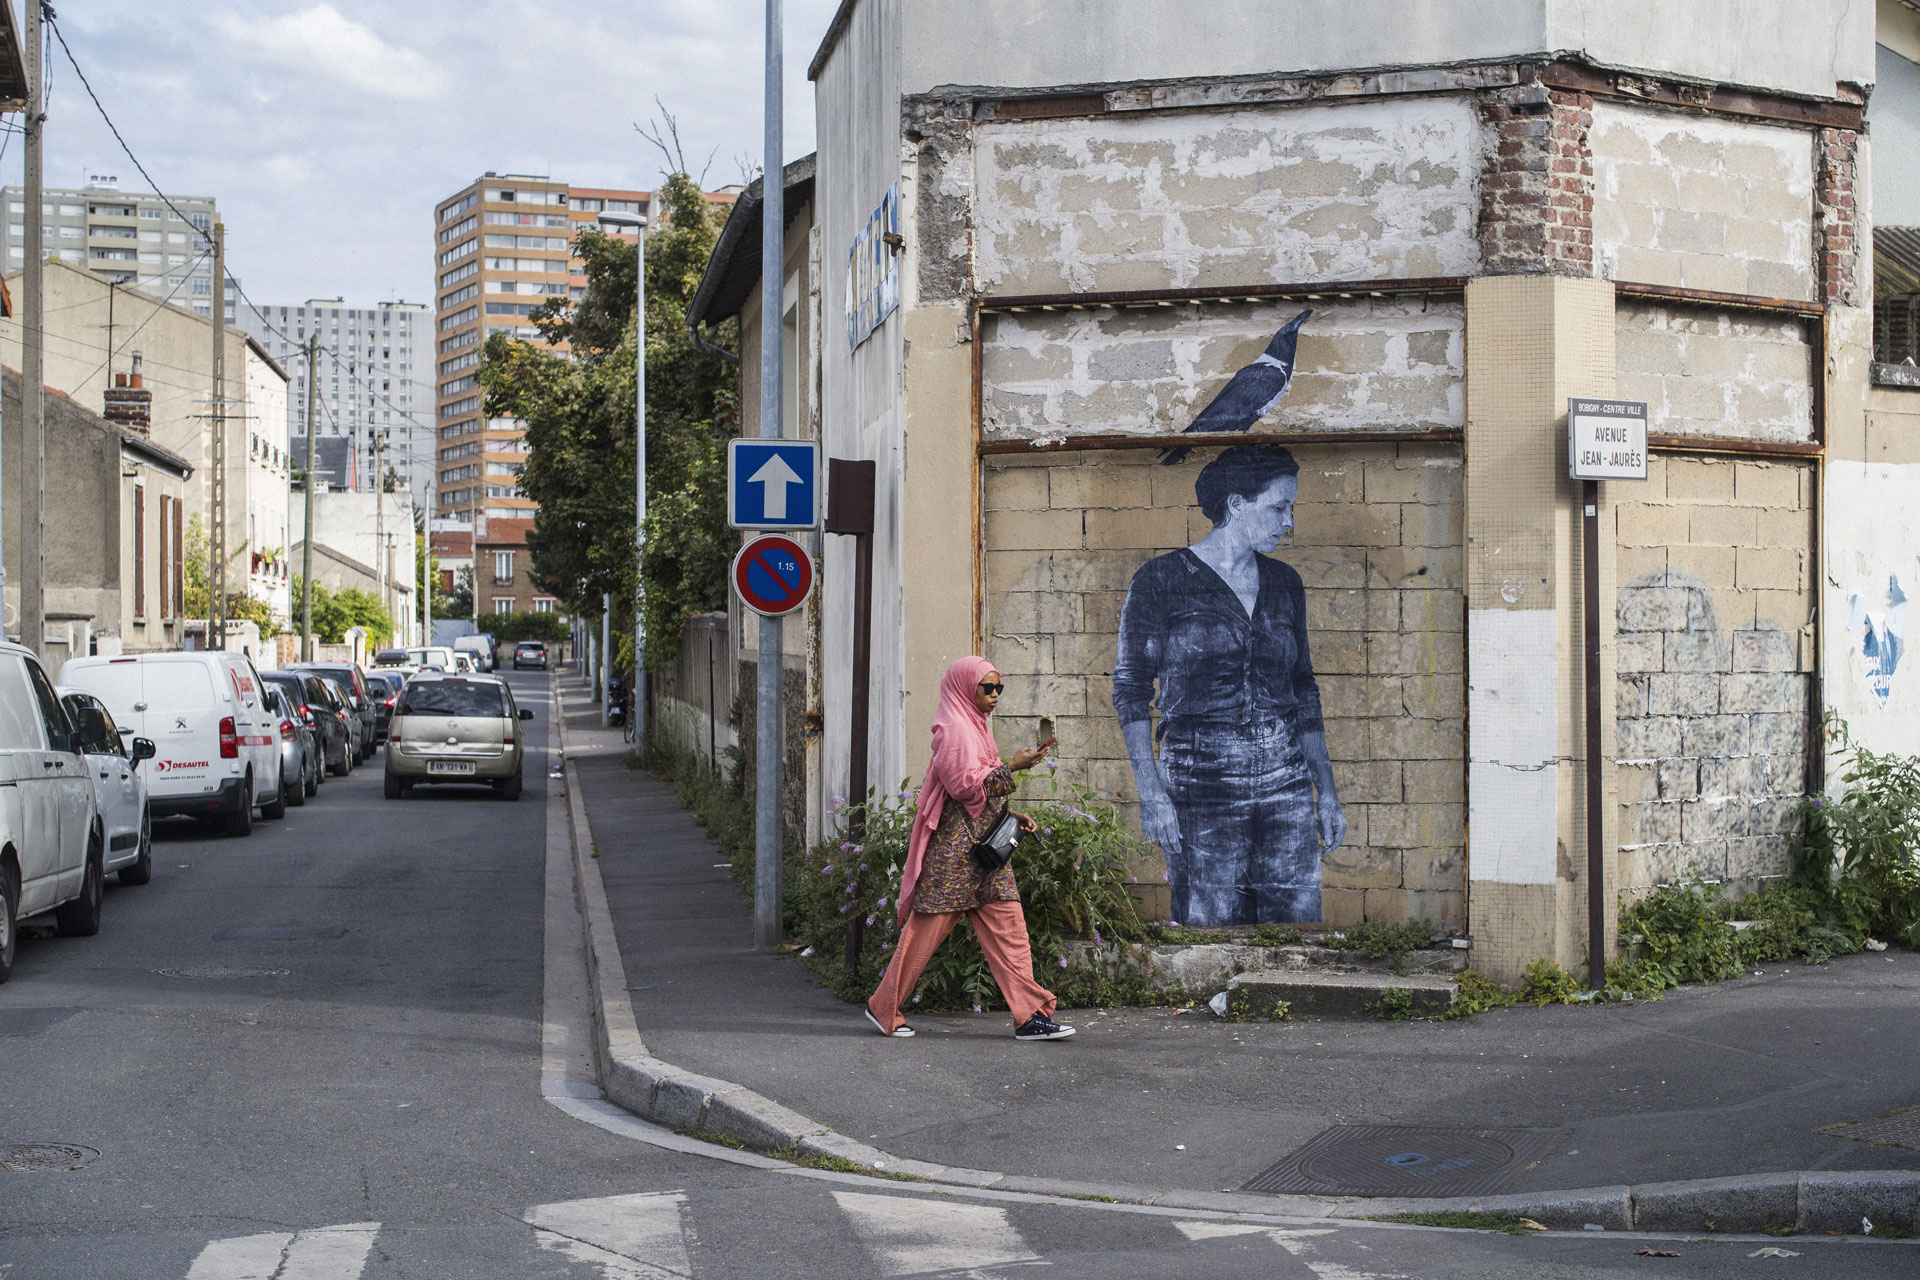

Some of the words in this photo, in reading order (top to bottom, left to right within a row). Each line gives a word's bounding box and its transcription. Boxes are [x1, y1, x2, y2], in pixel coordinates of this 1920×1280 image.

[1578, 403, 1600, 413] BOBIGNY
[1603, 404, 1626, 414] CENTRE
[1627, 405, 1641, 415] VILLE
[1595, 427, 1627, 443] AVENUE
[778, 561, 795, 571] 1.15
[172, 761, 210, 769] DESAUTEL
